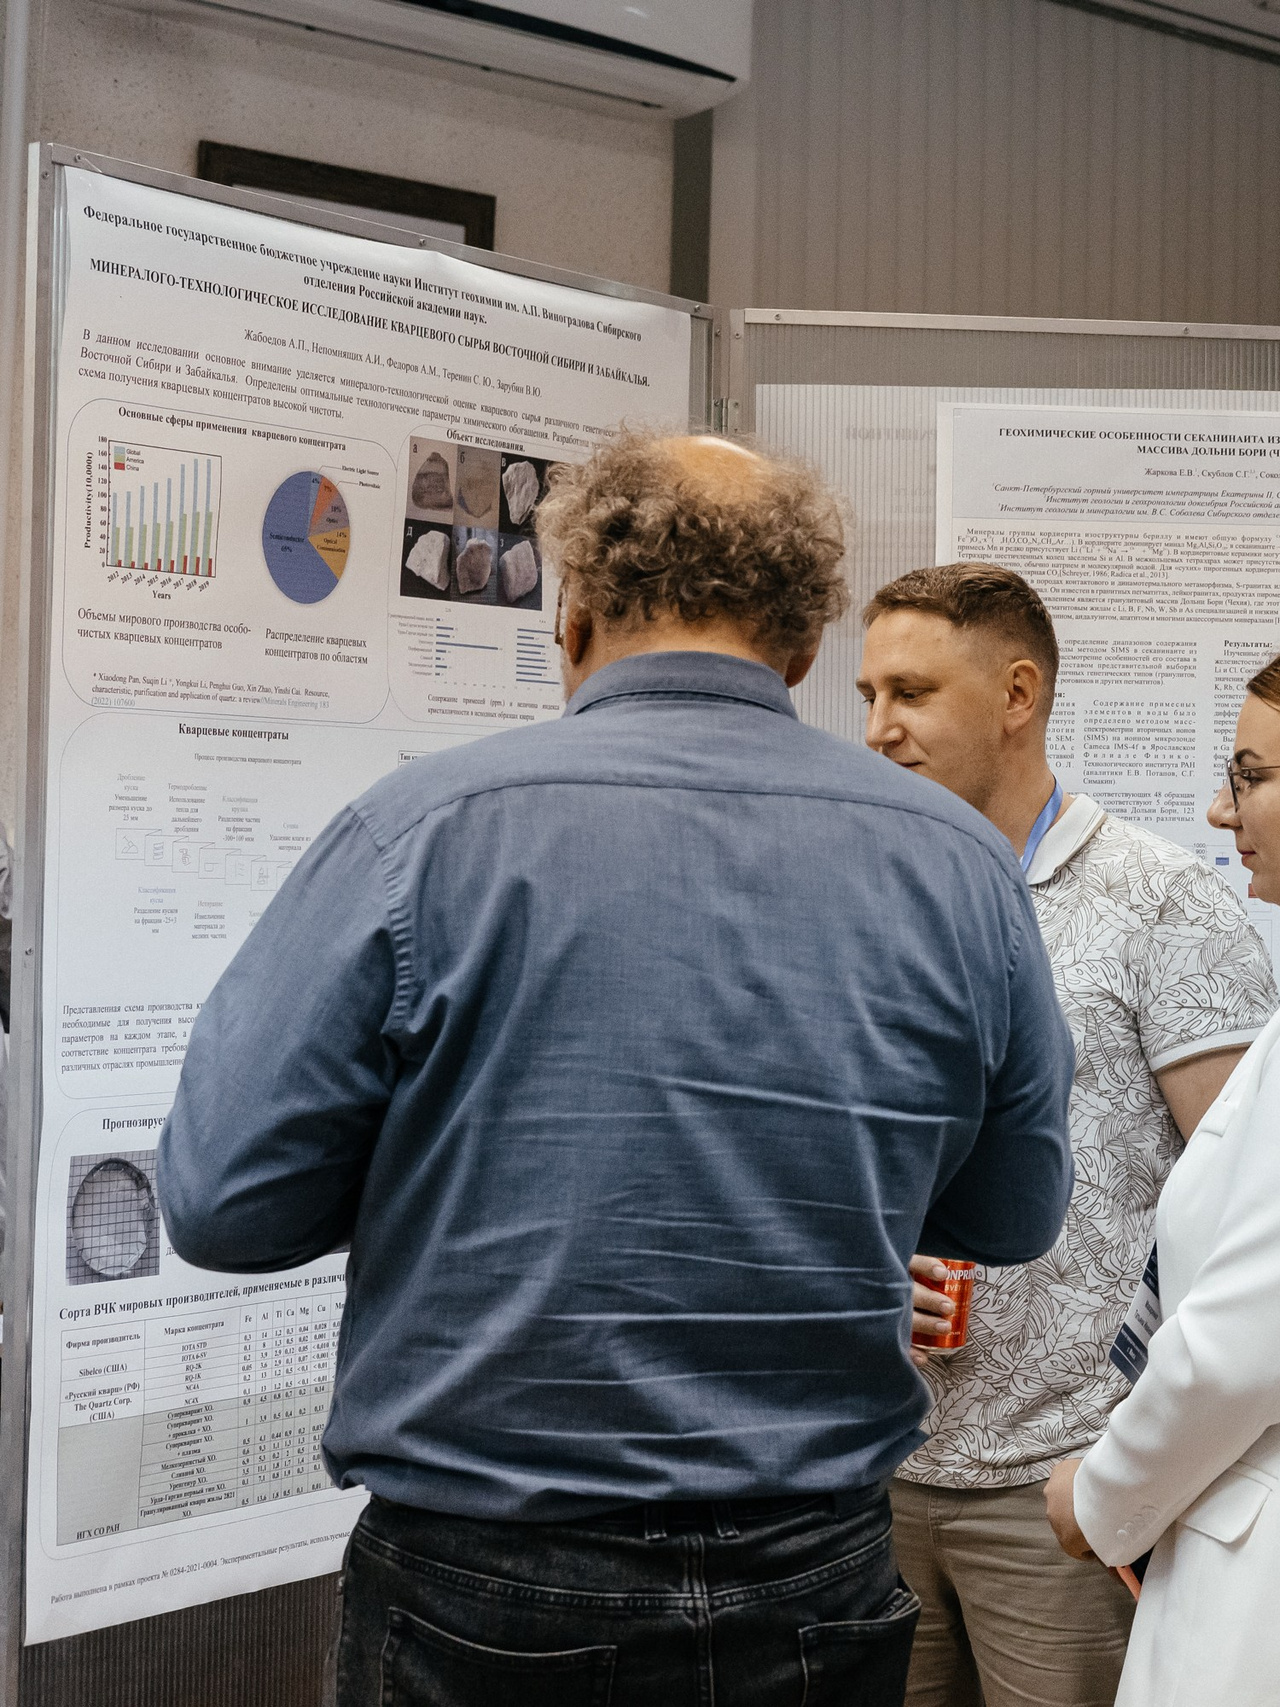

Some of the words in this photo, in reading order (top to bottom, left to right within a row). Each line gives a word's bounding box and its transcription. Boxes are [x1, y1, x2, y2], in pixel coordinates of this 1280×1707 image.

[83, 205, 163, 233] Федеральное
[166, 225, 257, 254] государственное
[259, 243, 318, 267] бюджетное
[320, 259, 380, 281] учреждение
[383, 273, 411, 287] науки
[414, 277, 458, 300] Институт
[461, 291, 503, 309] геохимии
[505, 301, 520, 312] им.
[522, 304, 540, 317] А.П.
[542, 307, 595, 330] Виноградова
[596, 320, 642, 341] Сибирского
[303, 275, 356, 295] отделения
[359, 284, 414, 308] Российской
[416, 300, 461, 318] академии
[464, 311, 487, 325] наук.
[90, 258, 299, 311] МИНЕРАЛОГО-ТЕХНОЛОГИЧЕСКОЕ
[302, 301, 388, 330] ИССЛЕДОВАНИЕ
[390, 320, 456, 343] КВАРЦЕВОГО
[457, 334, 490, 351] СЫРЬЯ
[492, 342, 549, 364] ВОСТОЧНОЙ
[551, 355, 586, 372] СИБИРИ
[588, 363, 594, 374] И
[596, 365, 650, 386] ЗАБАЙКАЛЬЯ.
[82, 328, 91, 340] В
[95, 334, 131, 347] данном
[136, 341, 199, 359] исследовании
[205, 353, 246, 368] основное
[251, 361, 292, 376] внимание
[296, 369, 335, 384] уделяется
[340, 377, 449, 405] минералого-технологической
[452, 399, 477, 410] оценке
[244, 328, 287, 347] Жабоедов
[288, 338, 310, 352] А.П.,
[364, 353, 385, 367] А.И.,
[386, 357, 419, 373] Федоров
[420, 364, 441, 378] А.М.,
[442, 367, 472, 383] Теренин
[496, 378, 524, 394] Зарубин
[525, 384, 542, 397] В.Ю.
[78, 367, 106, 379] схема
[108, 372, 158, 388] получения
[160, 380, 210, 396] кварцевых
[212, 389, 271, 406] концентратов
[272, 399, 307, 412] высокой
[309, 405, 344, 419] чистоты.
[80, 346, 132, 366] Восточной
[135, 356, 172, 374] Сибири
[175, 365, 181, 374] и
[185, 364, 238, 383] Забайкалья.
[245, 374, 297, 393] Определены
[300, 387, 354, 404] оптимальные
[356, 397, 420, 416] технологические
[422, 409, 461, 425] параметры
[463, 416, 507, 431] химического
[508, 423, 549, 440] обогащения.
[118, 406, 164, 422] Основные
[165, 414, 193, 428] сферы
[196, 420, 247, 435] применения
[251, 429, 297, 443] кварцевого
[298, 436, 346, 451] концентрата
[999, 428, 1096, 438] ГЕОХИМИЧЕСКИЕ
[1098, 431, 1181, 441] ОСОБЕННОСТИ
[1184, 433, 1264, 443] СЕКАНИНАИТА
[1268, 435, 1280, 444] ИЗ
[446, 428, 473, 443] Объект
[474, 436, 525, 452] исследования.
[1137, 445, 1189, 454] МАССИВА
[1191, 446, 1235, 456] ДОЛЬНИ
[1238, 448, 1266, 456] БОРИ
[1144, 467, 1177, 477] Жаркова
[1201, 469, 1234, 479] Скублов
[1083, 487, 1112, 496] горный
[1112, 489, 1164, 497] университет
[1165, 490, 1219, 498] императрицы
[1220, 489, 1264, 500] Екатерины
[1266, 491, 1274, 499] II,
[152, 590, 172, 600] Years
[77, 607, 116, 622] Объемы
[118, 614, 162, 627] мирового
[163, 618, 222, 632] производства
[223, 622, 251, 634] особо-
[77, 628, 111, 639] чистых
[114, 631, 161, 644] кварцевых
[164, 636, 223, 650] концентратов
[265, 627, 325, 644] Распределение
[326, 636, 367, 648] кварцевых
[1224, 639, 1273, 650] Результаты:
[264, 648, 319, 661] концентратов
[320, 652, 330, 661] по
[331, 651, 368, 664] областям
[178, 723, 230, 738] Кварцевые
[232, 729, 289, 742] концентраты
[62, 1004, 121, 1016] Представленная
[124, 1004, 145, 1012] схема
[147, 1003, 193, 1013] производства
[102, 1116, 166, 1132] Прогнозируе
[59, 1308, 91, 1321] Сорта
[94, 1301, 117, 1315] ВЧК
[119, 1298, 163, 1313] мировых
[166, 1285, 240, 1308] производителей,
[242, 1279, 302, 1297] применяемые
[304, 1278, 310, 1286] в
[164, 1327, 186, 1336] Марка
[187, 1320, 224, 1332] концентрата
[65, 1340, 90, 1349] Фирма
[91, 1333, 141, 1347] производитель
[79, 1367, 102, 1377] Sibelco
[103, 1363, 128, 1374] (США)
[74, 1402, 87, 1411] The
[88, 1400, 112, 1411] Quartz
[113, 1397, 132, 1406] Corp.
[89, 1411, 114, 1423] (США)
[76, 1529, 92, 1540] ИГХ
[93, 1526, 106, 1536] СО
[106, 1523, 120, 1534] РАН
[50, 1593, 73, 1604] Работа
[73, 1585, 107, 1599] выполнена
[114, 1579, 135, 1591] рамках
[136, 1573, 160, 1585] проекта
[169, 1558, 219, 1576] 0284-2021-0004.
